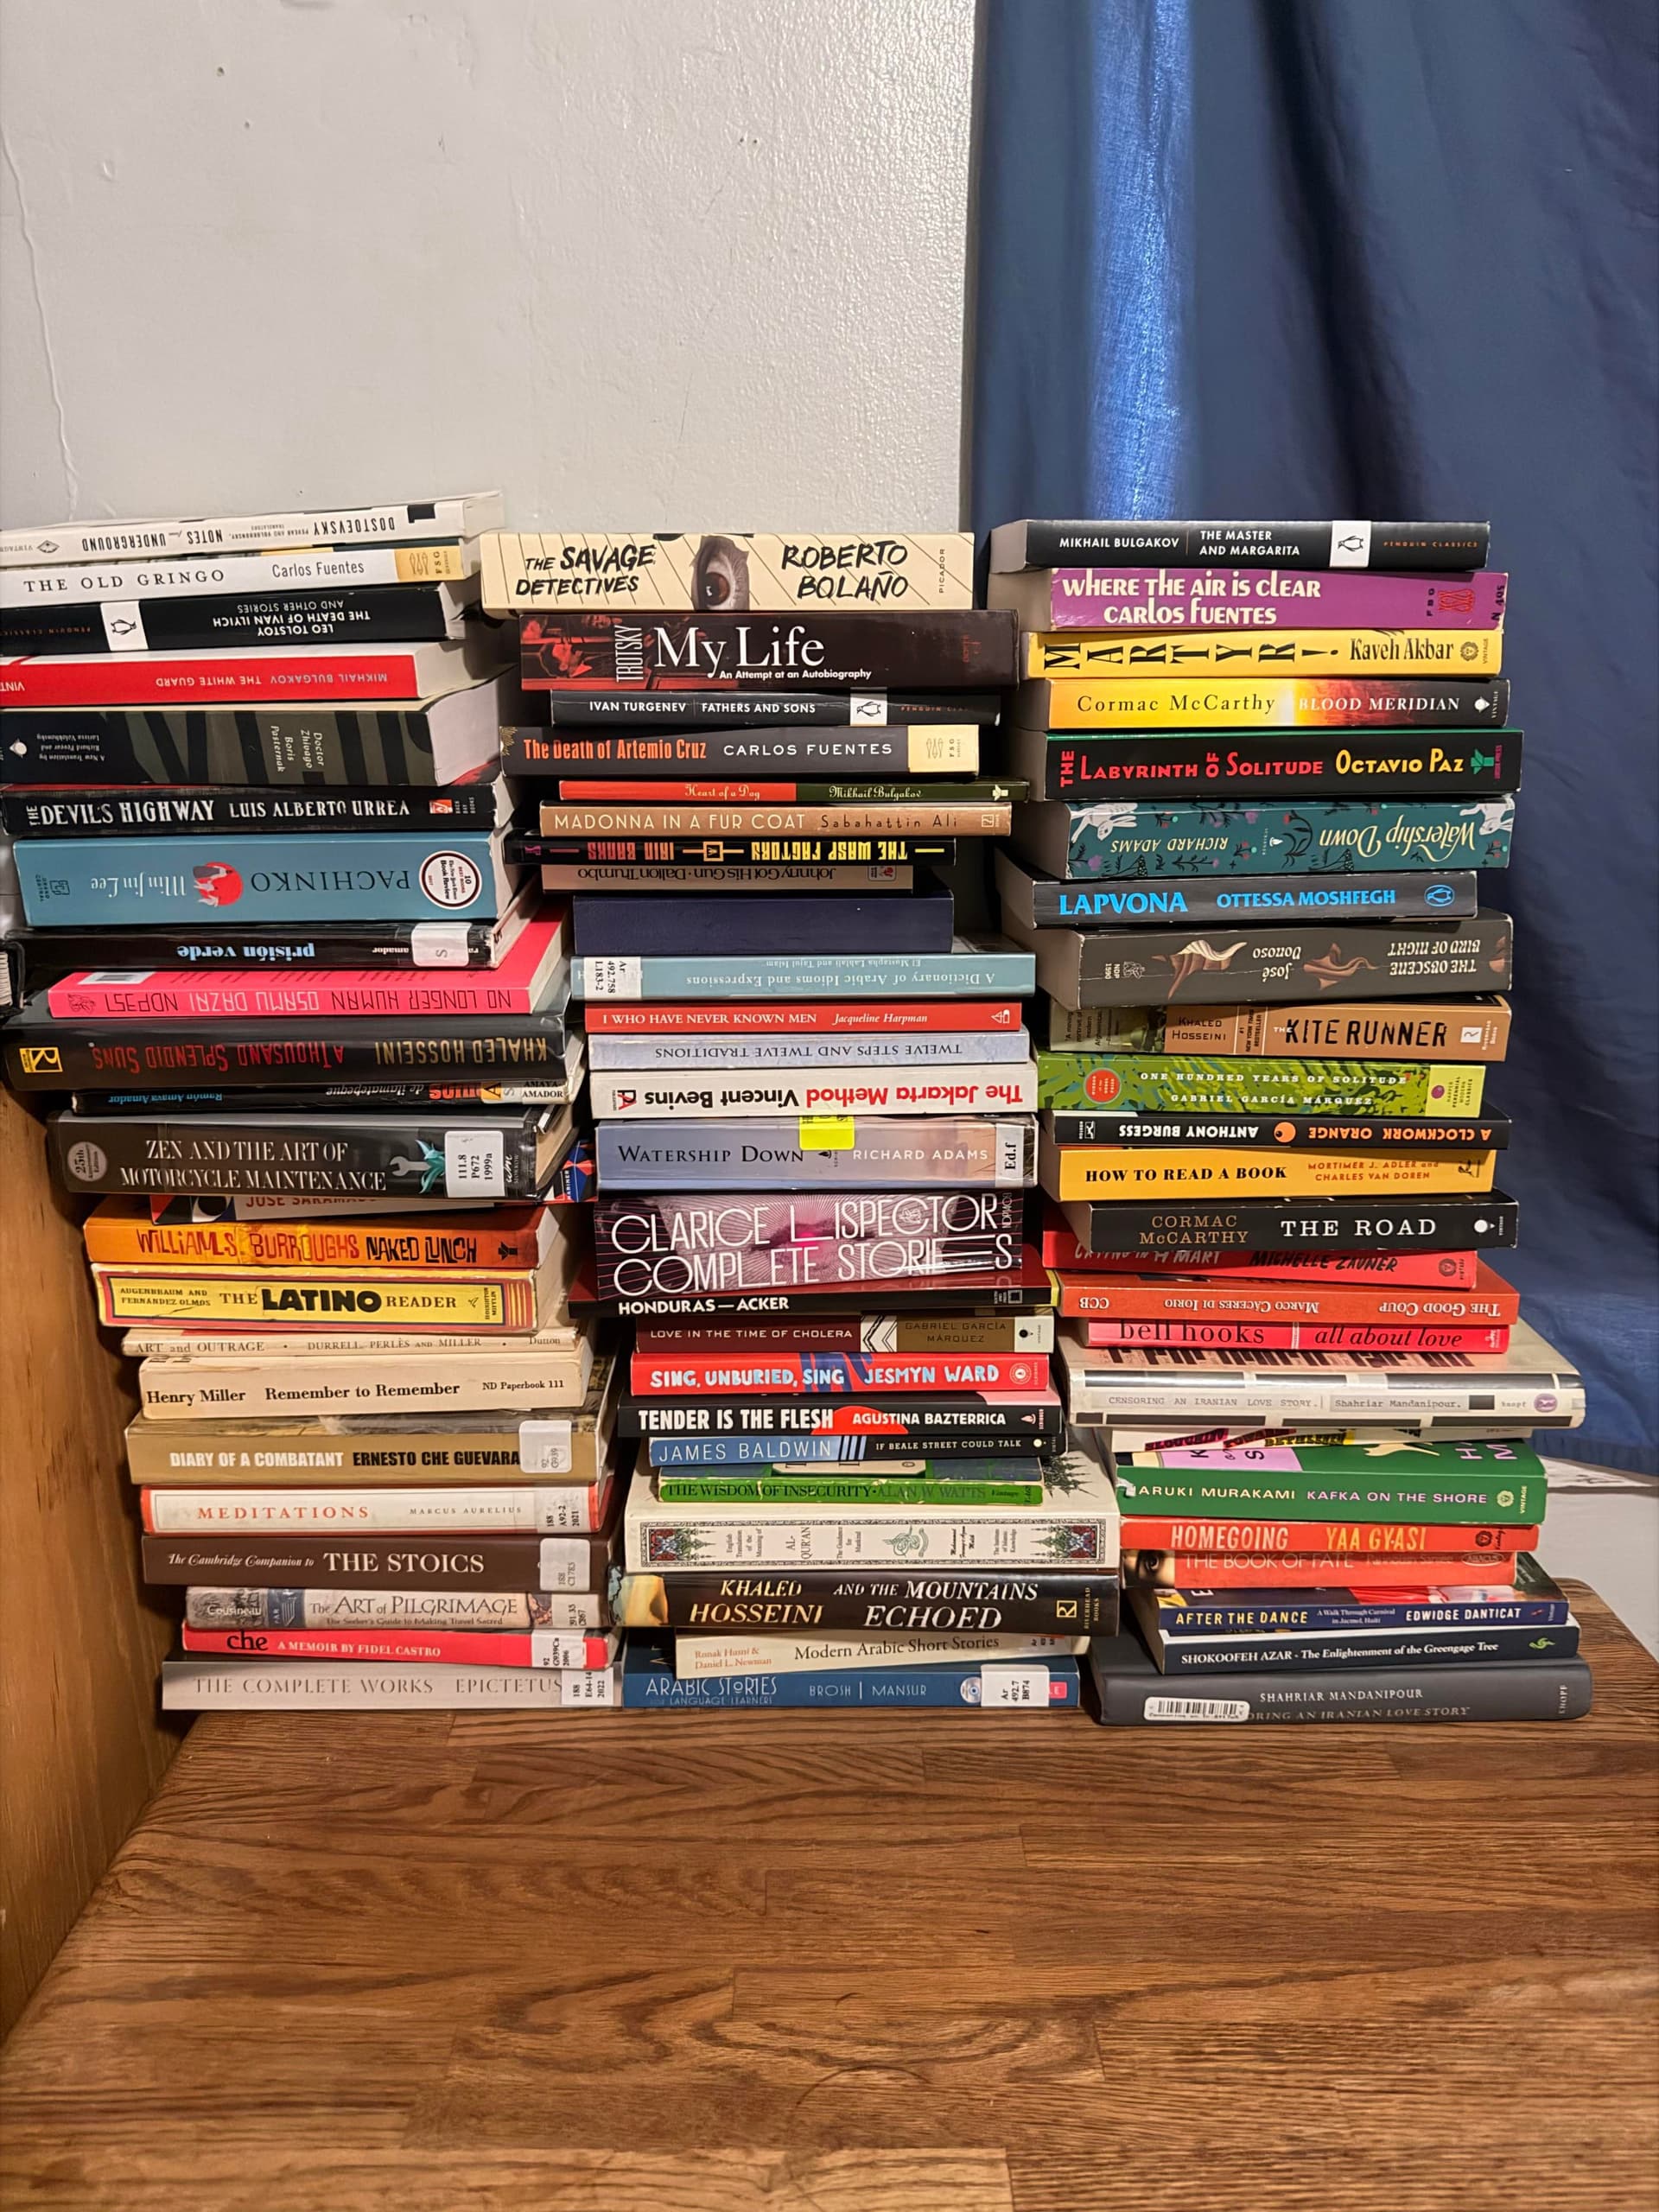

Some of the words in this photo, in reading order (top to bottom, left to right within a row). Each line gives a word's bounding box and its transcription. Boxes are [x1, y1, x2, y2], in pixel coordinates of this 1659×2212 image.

[314, 517, 394, 536] DOSTOEVSKY
[1200, 531, 1222, 540] THE
[1225, 531, 1272, 541] MASTER
[82, 532, 166, 551] UNDERGROUND
[188, 529, 223, 544] NOTES
[1059, 537, 1110, 548] MIKHAIL
[1115, 537, 1179, 548] BULGAKOV
[525, 558, 556, 570] THE
[561, 544, 657, 574] SAVAGE
[782, 540, 907, 569] ROBERTO
[1199, 546, 1225, 556] AND
[1230, 545, 1300, 556] MARGARITA
[24, 581, 67, 593] THE
[81, 576, 123, 589] OLD
[137, 569, 225, 586] GRINGO
[272, 563, 311, 578] Carlos
[316, 561, 365, 576] Fuentes
[516, 575, 639, 595] DETECTIVES
[797, 571, 908, 601] BOLAÑO
[213, 616, 251, 627] ILYICH
[254, 615, 284, 626] IVAN
[288, 613, 302, 624] OF
[308, 612, 345, 622] DEATH
[348, 610, 370, 620] THE
[614, 626, 644, 682] TROTSKY
[654, 626, 727, 678] My
[735, 626, 824, 667] Life
[735, 671, 772, 681] Attempt
[802, 670, 872, 681] Autobiography
[1077, 696, 1159, 712] Cormac
[1170, 694, 1274, 714] McCarthy
[1299, 698, 1362, 710] BLOOD
[1369, 698, 1460, 710] MERIDIAN
[270, 726, 285, 772] Pasternak
[283, 736, 294, 762] Boris
[313, 733, 325, 766] Doctor
[524, 739, 549, 760] The
[553, 740, 593, 760] Death
[597, 740, 611, 759] of
[617, 739, 672, 760] Artemio
[676, 740, 707, 759] Cruz
[723, 744, 798, 756] CARLOS
[807, 744, 892, 755] FUENTES
[555, 815, 655, 830] MADONNA
[663, 815, 680, 829] IN
[690, 815, 700, 829] A
[709, 815, 741, 829] FUR
[751, 814, 805, 830] COAT
[821, 816, 920, 829] Sabahattin
[932, 815, 957, 827] Ali
[1110, 840, 1161, 852] ADAMS
[1167, 837, 1228, 851] RICHARD
[1319, 826, 1381, 857] Down
[1386, 814, 1476, 862] Watership
[1058, 892, 1188, 916] LAPVONA
[1217, 893, 1294, 907] OTTESSA
[1298, 890, 1395, 906] MOSHFEGH
[177, 945, 237, 960] verde
[243, 943, 315, 962] prisión
[603, 1014, 607, 1024] I
[612, 1014, 645, 1024] WHO
[650, 1014, 683, 1024] HAVE
[687, 1014, 728, 1024] NEVER
[733, 1014, 784, 1023] KNOWN
[789, 1014, 816, 1023] MEN
[832, 1014, 880, 1026] Jacqueline
[883, 1014, 927, 1026] Harpman
[1333, 1076, 1408, 1084] SOLITUDE
[645, 1090, 713, 1109] Bevins
[721, 1089, 799, 1108] Vincent
[806, 1087, 888, 1108] Method
[896, 1085, 979, 1104] Jakarta
[985, 1084, 1023, 1103] The
[458, 1154, 467, 1179] 111.8
[471, 1155, 480, 1179] P672
[484, 1154, 493, 1181] 1999a
[1085, 1170, 1128, 1182] HOW
[1134, 1169, 1157, 1181] TO
[1163, 1168, 1212, 1180] READ
[1218, 1168, 1229, 1179] A
[1236, 1166, 1287, 1179] BOOK
[219, 1293, 257, 1305] THE
[261, 1288, 381, 1313] LATINO
[387, 1296, 456, 1308] READER
[147, 1391, 194, 1406] Henry
[200, 1389, 245, 1402] Miller
[265, 1386, 349, 1400] Remember
[356, 1388, 370, 1397] to
[377, 1382, 460, 1396] Remember
[500, 1381, 544, 1391] Paperbook
[1109, 1396, 1165, 1405] CENSORING
[1195, 1398, 1237, 1407] IRANIAN
[658, 1443, 726, 1462] JAMES
[739, 1440, 831, 1459] BALDWIN
[1132, 1486, 1192, 1497] ARUKI
[1201, 1488, 1295, 1499] MURAKAMI
[1307, 1491, 1360, 1501] KAFKA
[1368, 1492, 1390, 1501] ON
[1397, 1493, 1426, 1502] THE
[1433, 1493, 1487, 1503] SHORE
[197, 1507, 369, 1519] MEDITATIONS
[168, 1554, 184, 1564] The
[188, 1554, 242, 1567] Cambridge
[245, 1555, 302, 1567] Companion
[304, 1557, 314, 1567] to
[323, 1554, 378, 1571] THE
[388, 1554, 484, 1573] STOICS
[721, 1580, 802, 1597] KHALED
[833, 1583, 864, 1596] AND
[870, 1584, 899, 1596] THE
[904, 1580, 1039, 1600] MOUNTAINS
[690, 1603, 823, 1624] HOSSEINI
[864, 1605, 1002, 1630] ECHOED
[795, 1646, 852, 1661] Modern
[857, 1640, 904, 1656] Arabic
[908, 1638, 947, 1652] Short
[951, 1637, 999, 1650] Stories
[1181, 1654, 1257, 1664] SHOKOOFEH
[1261, 1651, 1292, 1662] AZAR
[1301, 1650, 1320, 1660] The
[1322, 1648, 1392, 1661] Enlightenment
[1395, 1644, 1407, 1655] of
[1424, 1643, 1475, 1655] Greengage
[1478, 1643, 1498, 1651] Tree
[194, 1679, 232, 1693] THE
[244, 1679, 351, 1694] COMPLETE
[360, 1679, 433, 1694] WORKS
[456, 1678, 562, 1693] EPICTETUS
